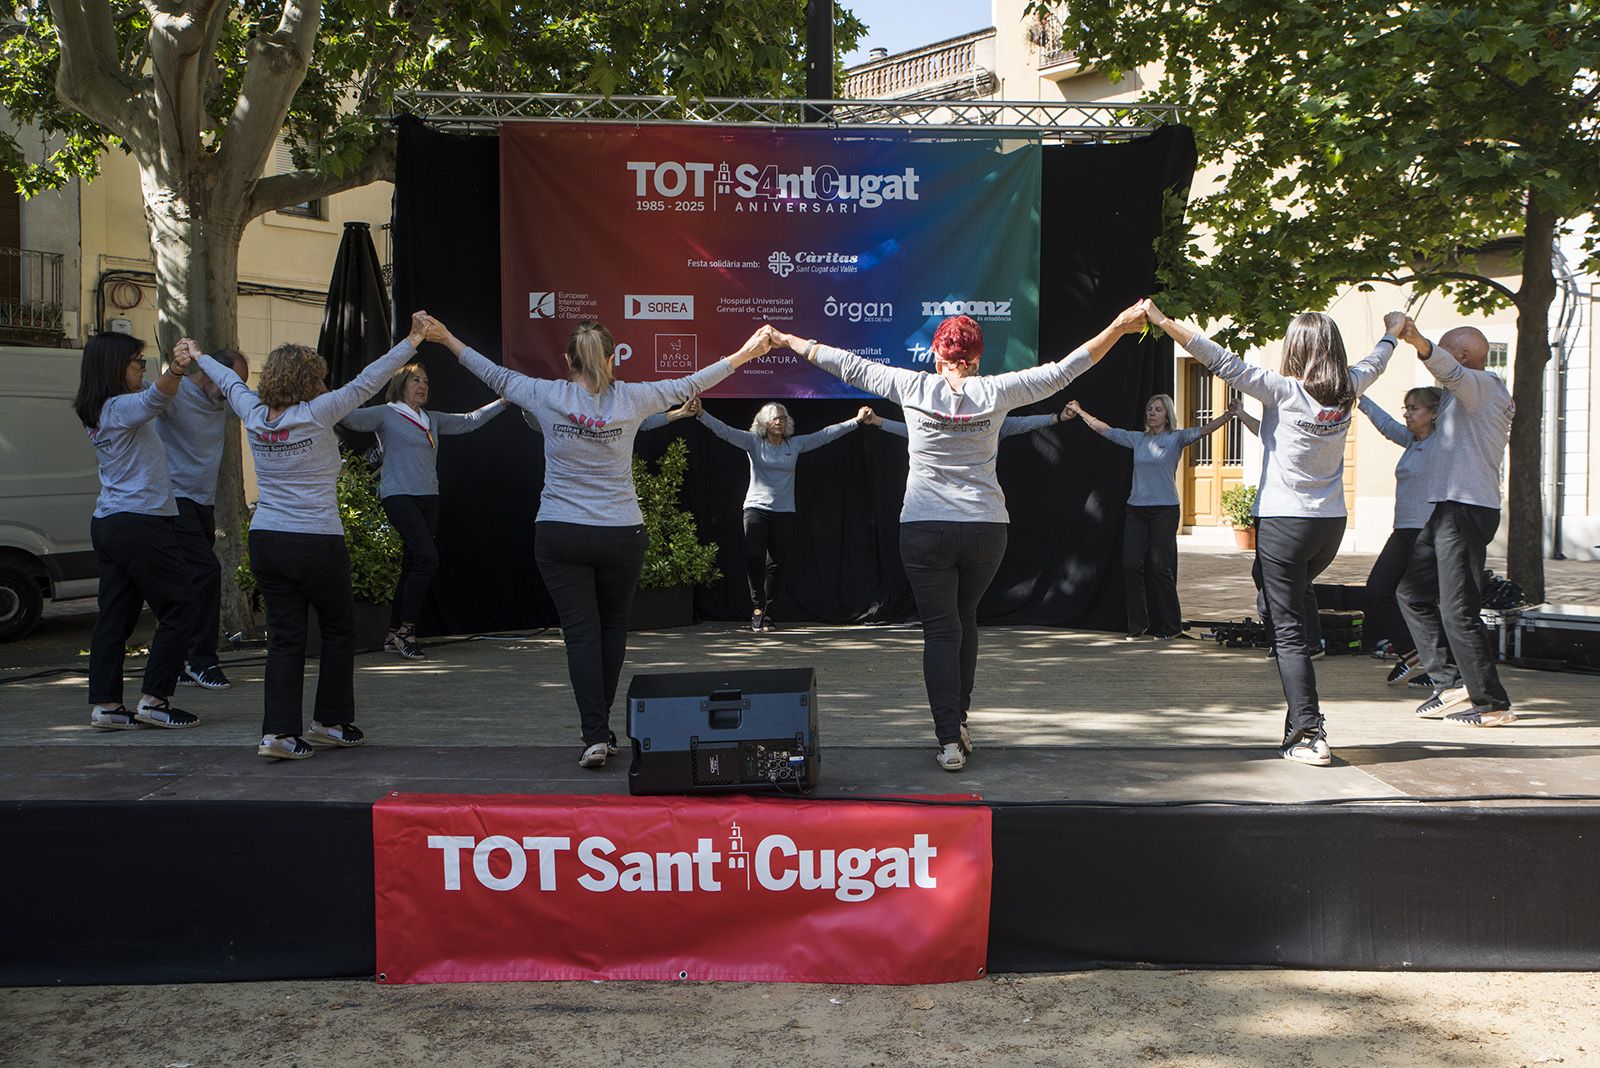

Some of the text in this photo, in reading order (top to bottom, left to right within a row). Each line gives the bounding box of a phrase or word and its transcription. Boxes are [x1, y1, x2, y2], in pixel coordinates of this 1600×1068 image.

[627, 161, 714, 197] TOT
[636, 200, 665, 211] 1985
[675, 200, 705, 212] 2025
[735, 202, 857, 213] ANIVERSARI
[795, 251, 859, 263] Càritas
[687, 258, 761, 268] Festa solidària amb:
[795, 265, 858, 274] Sant Cugat del Vallès
[558, 292, 589, 300] European
[752, 297, 794, 305] Universitari
[558, 305, 581, 313] School
[648, 302, 688, 313] SOREA
[756, 306, 794, 314] Catalunya
[921, 300, 1011, 316] moonz
[660, 360, 693, 368] DECOR
[757, 356, 798, 364] NATURA
[554, 425, 580, 434] Entitat
[427, 834, 937, 902] TOT Sant Cugat
